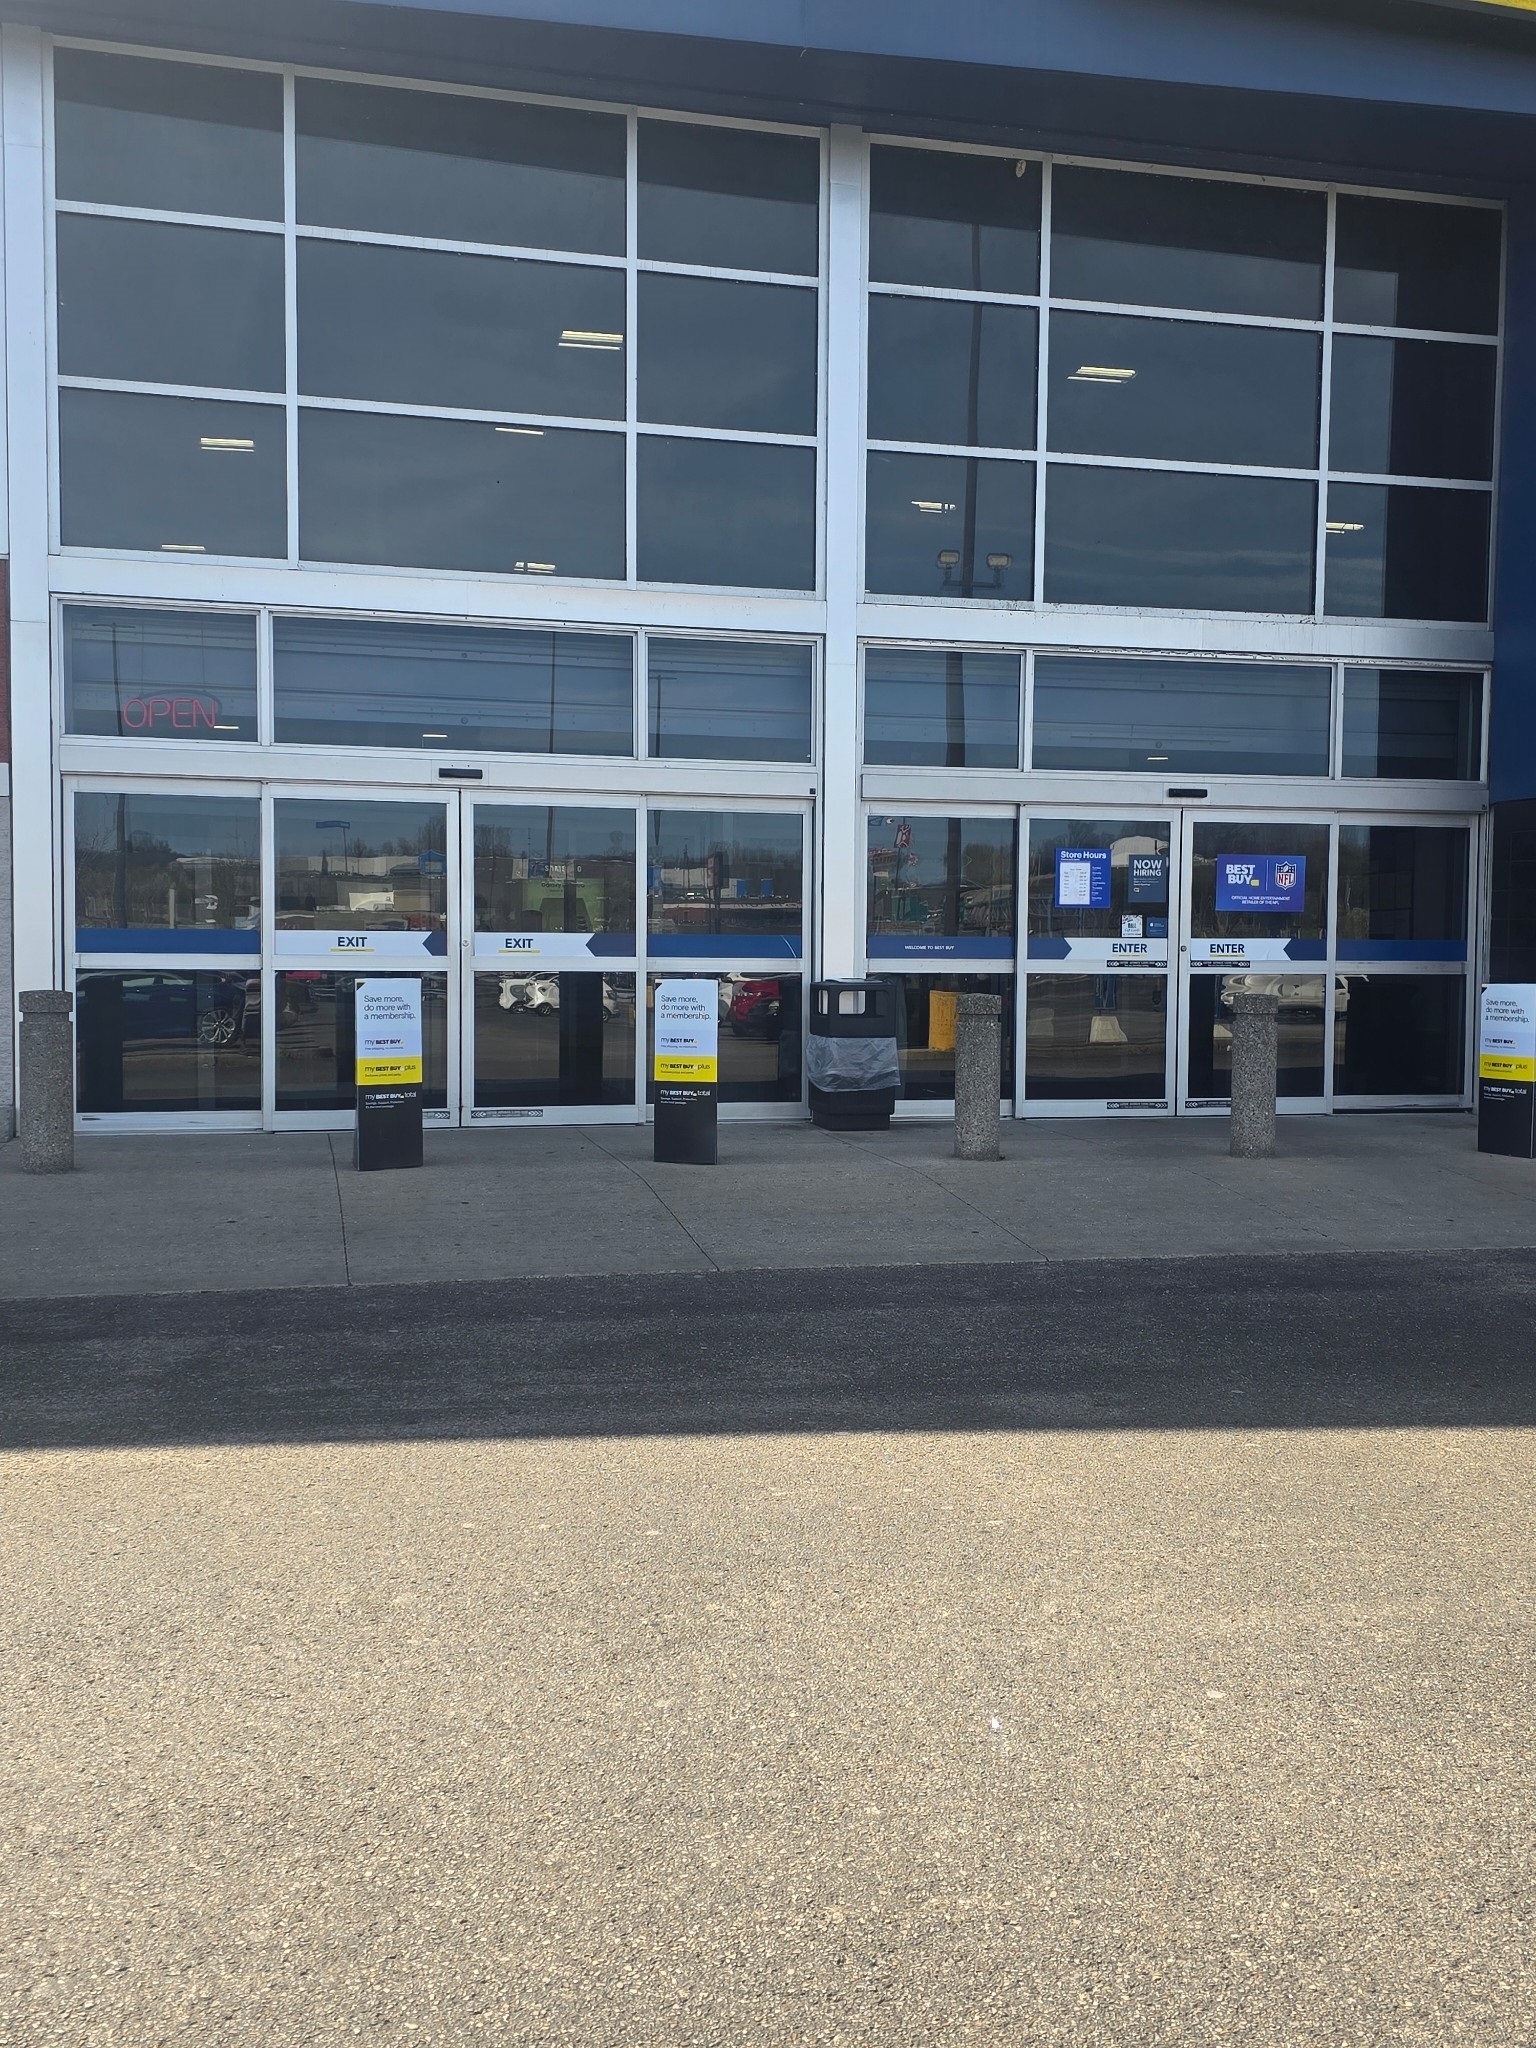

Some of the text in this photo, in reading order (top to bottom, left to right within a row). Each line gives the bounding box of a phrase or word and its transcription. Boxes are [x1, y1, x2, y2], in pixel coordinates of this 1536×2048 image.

[123, 698, 216, 728] OPEN
[1061, 851, 1107, 859] Store Hours
[1133, 859, 1162, 869] NOW
[1133, 869, 1162, 877] HIRING
[1226, 864, 1256, 875] BEST
[1227, 874, 1252, 885] BUY
[1278, 873, 1294, 886] NFL
[337, 936, 368, 948] EXIT
[505, 938, 534, 949] EXIT
[1112, 943, 1148, 953] ENTER
[1209, 943, 1245, 954] ENTER
[363, 995, 382, 1003] Save
[660, 994, 677, 1003] Save
[1485, 998, 1499, 1006] Save
[396, 1003, 411, 1011] with
[660, 1003, 670, 1011] do
[690, 1004, 706, 1012] with
[370, 1011, 416, 1020] membership.
[666, 1012, 712, 1021] membership.
[1489, 1015, 1530, 1023] membership.
